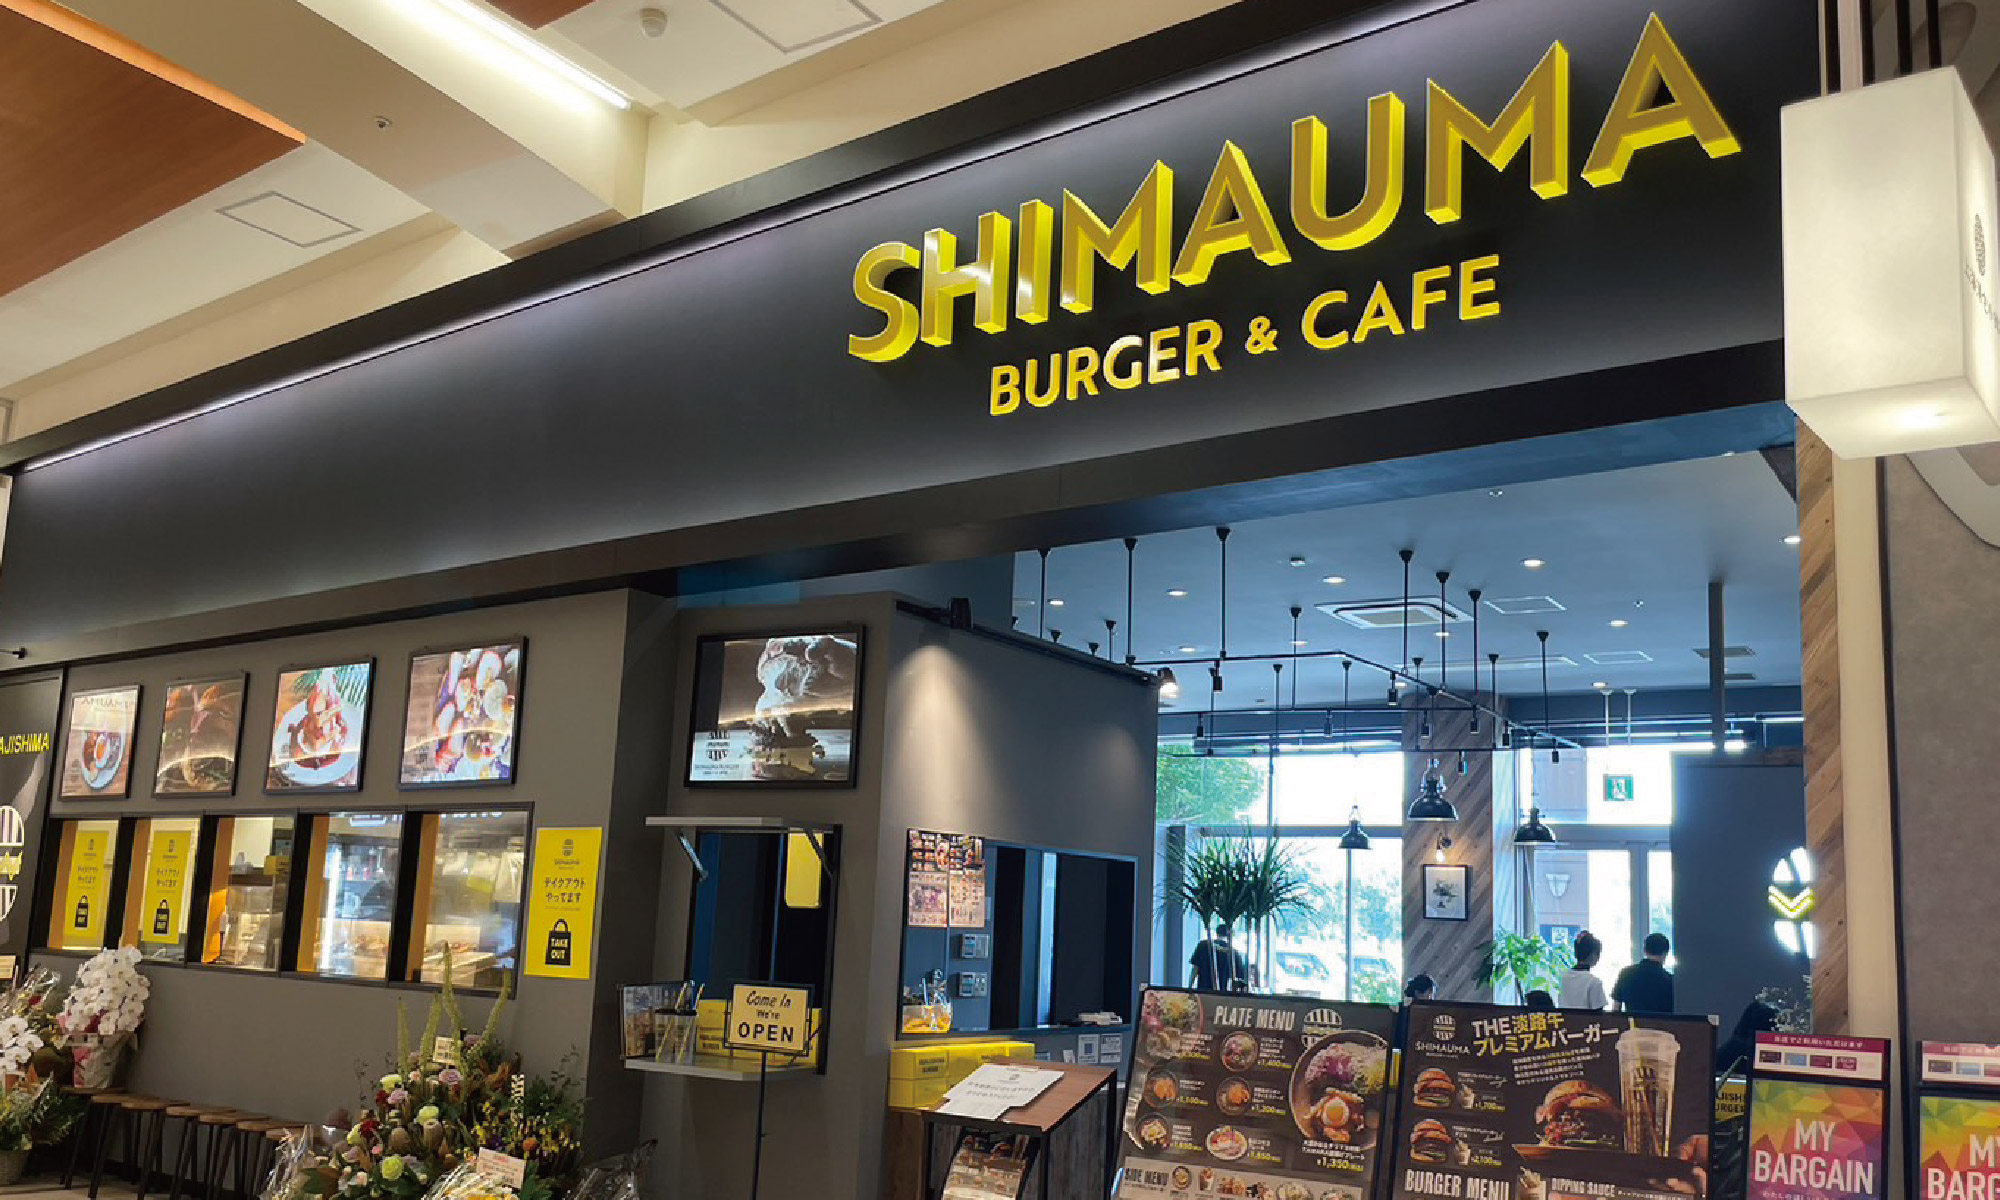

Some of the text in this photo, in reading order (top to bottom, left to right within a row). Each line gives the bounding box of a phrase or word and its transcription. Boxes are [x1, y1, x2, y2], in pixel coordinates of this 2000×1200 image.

[848, 11, 1741, 362] SHIMAUMA
[989, 254, 1501, 415] BURGER & CAFE
[544, 877, 586, 889] テイクアウト
[545, 892, 581, 903] やってます
[746, 990, 792, 1009] Come In
[1213, 1005, 1296, 1031] PLATE MENU
[738, 1021, 795, 1043] OPEN
[1472, 1024, 1619, 1057] プレミアムバーガー
[1415, 1040, 1470, 1054] SHIMAUMA
[1793, 1118, 1836, 1151] MY
[1404, 1168, 1510, 1200] BURGER MENU
[1754, 1150, 1873, 1194] BARGAIN
[1587, 1181, 1616, 1198] SAUCE
